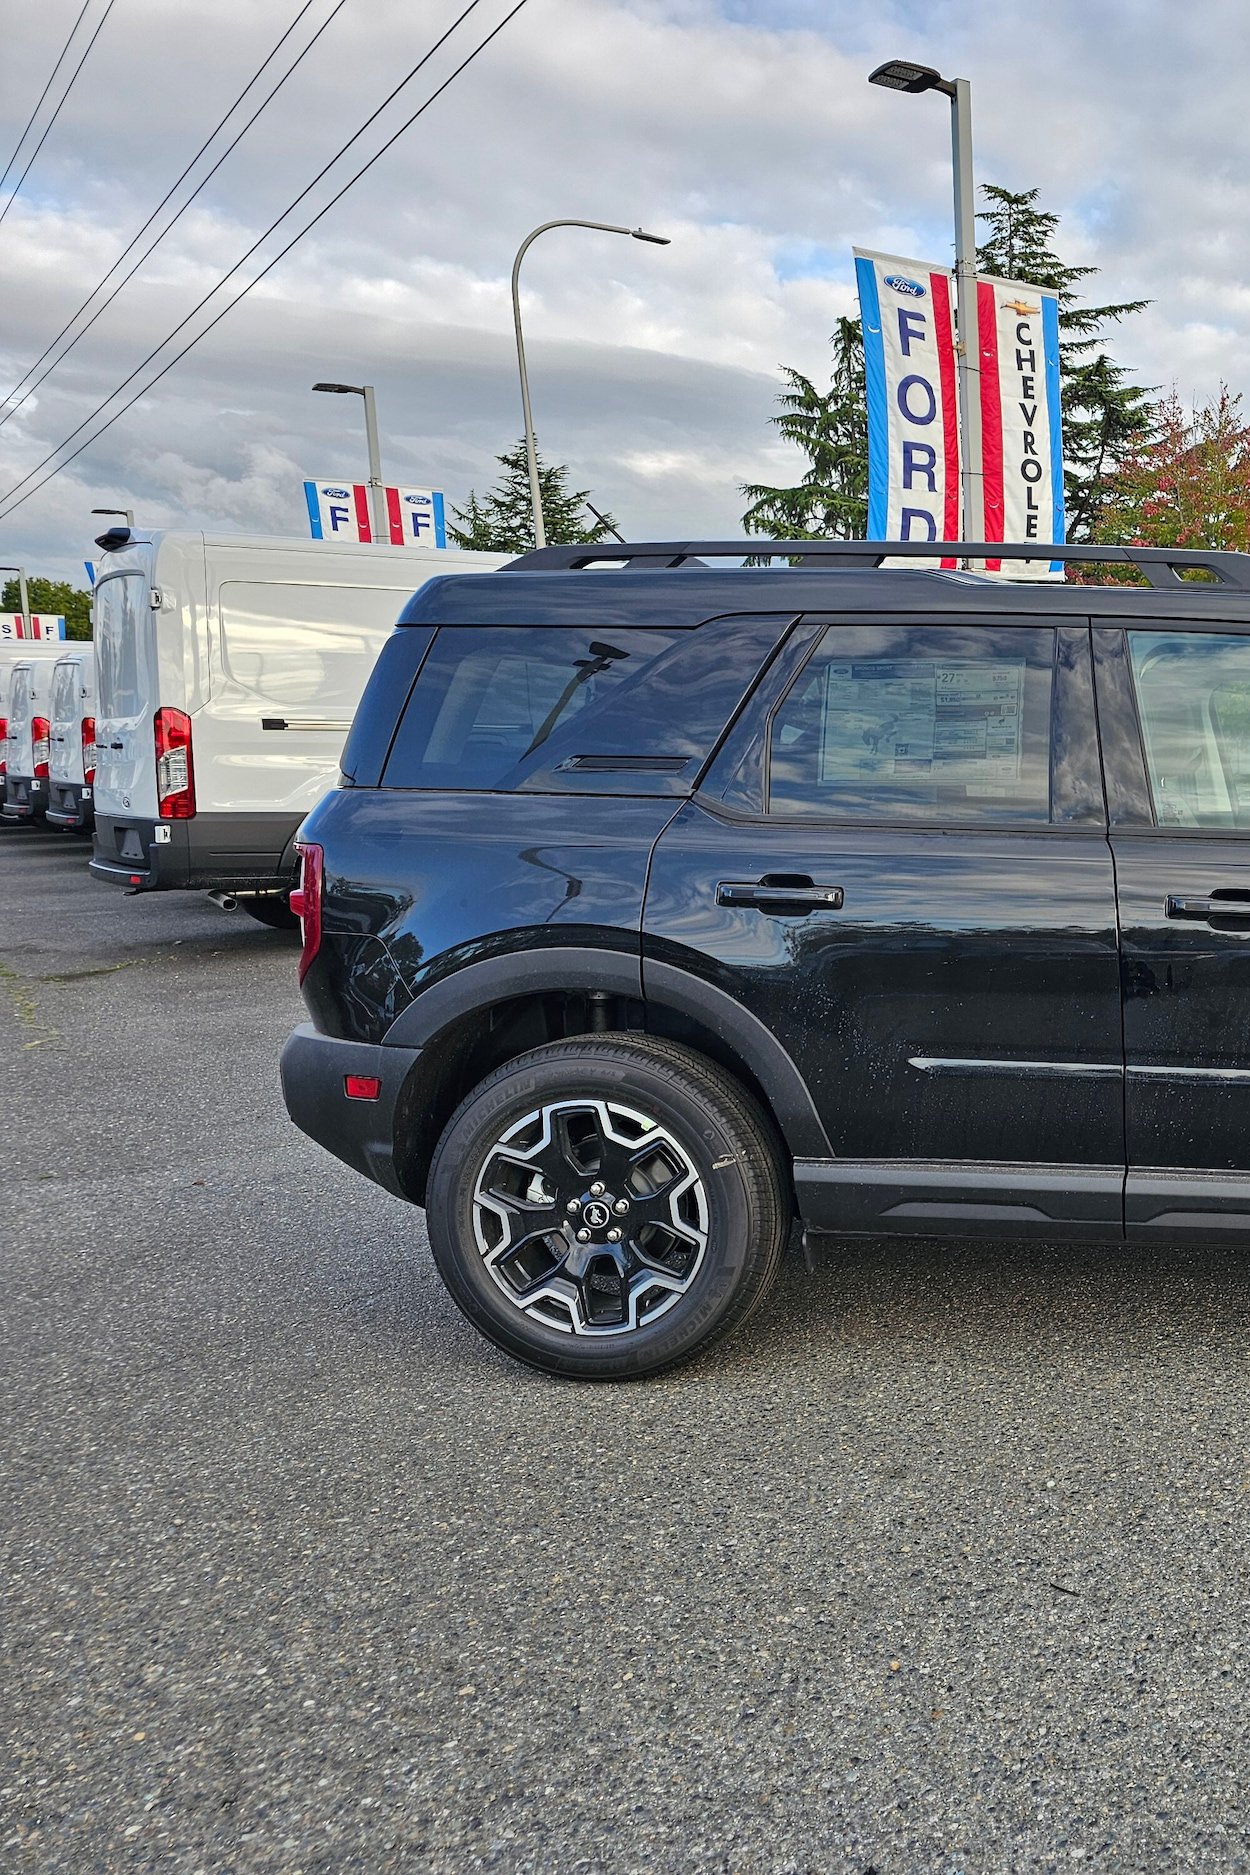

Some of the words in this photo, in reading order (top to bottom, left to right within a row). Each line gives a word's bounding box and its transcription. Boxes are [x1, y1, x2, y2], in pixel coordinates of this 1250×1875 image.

[891, 277, 918, 296] Ford
[897, 307, 937, 542] FORD
[1015, 322, 1043, 565] CHEVROLE
[326, 488, 346, 498] Ford
[409, 495, 428, 505] Ford
[941, 672, 955, 683] 27
[463, 1076, 536, 1138] MICHELIN
